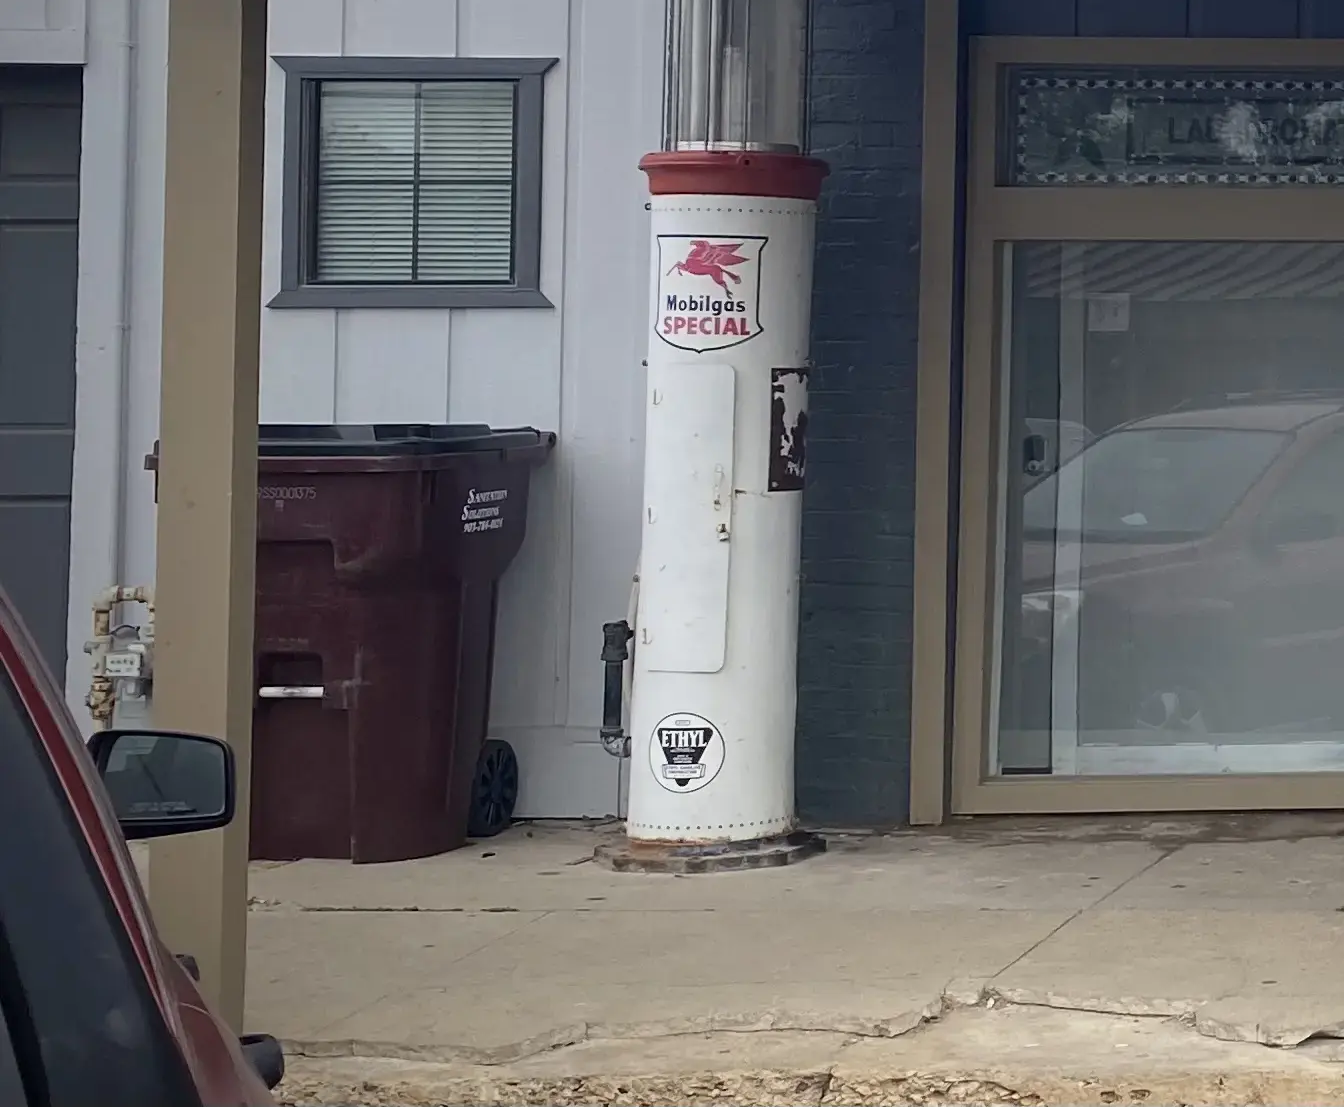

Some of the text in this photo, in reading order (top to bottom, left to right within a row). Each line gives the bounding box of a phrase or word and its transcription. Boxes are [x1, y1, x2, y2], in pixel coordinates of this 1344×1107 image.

[667, 295, 746, 316] Mobilgas
[664, 316, 750, 336] SPECIAL
[661, 729, 707, 747] ETHYL
